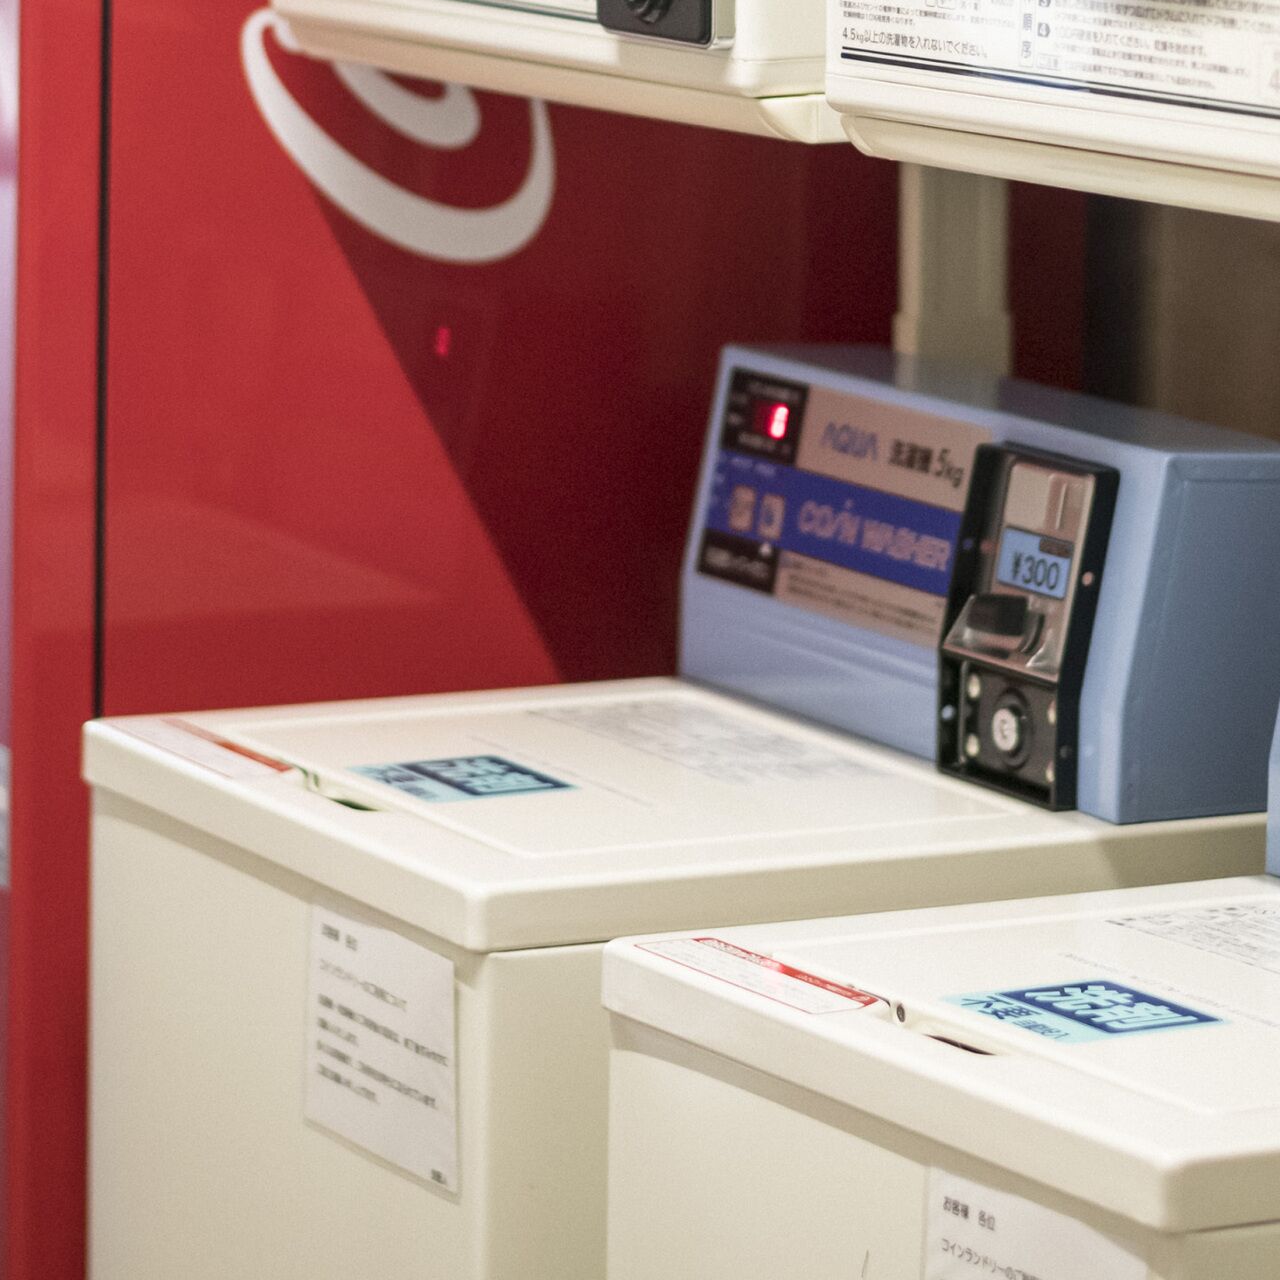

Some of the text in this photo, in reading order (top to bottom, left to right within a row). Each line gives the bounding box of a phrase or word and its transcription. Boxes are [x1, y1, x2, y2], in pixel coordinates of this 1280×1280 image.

[1011, 552, 1061, 591] ¥300
[1024, 984, 1199, 1029] 洗剤
[943, 1196, 996, 1231] お客様 各位
